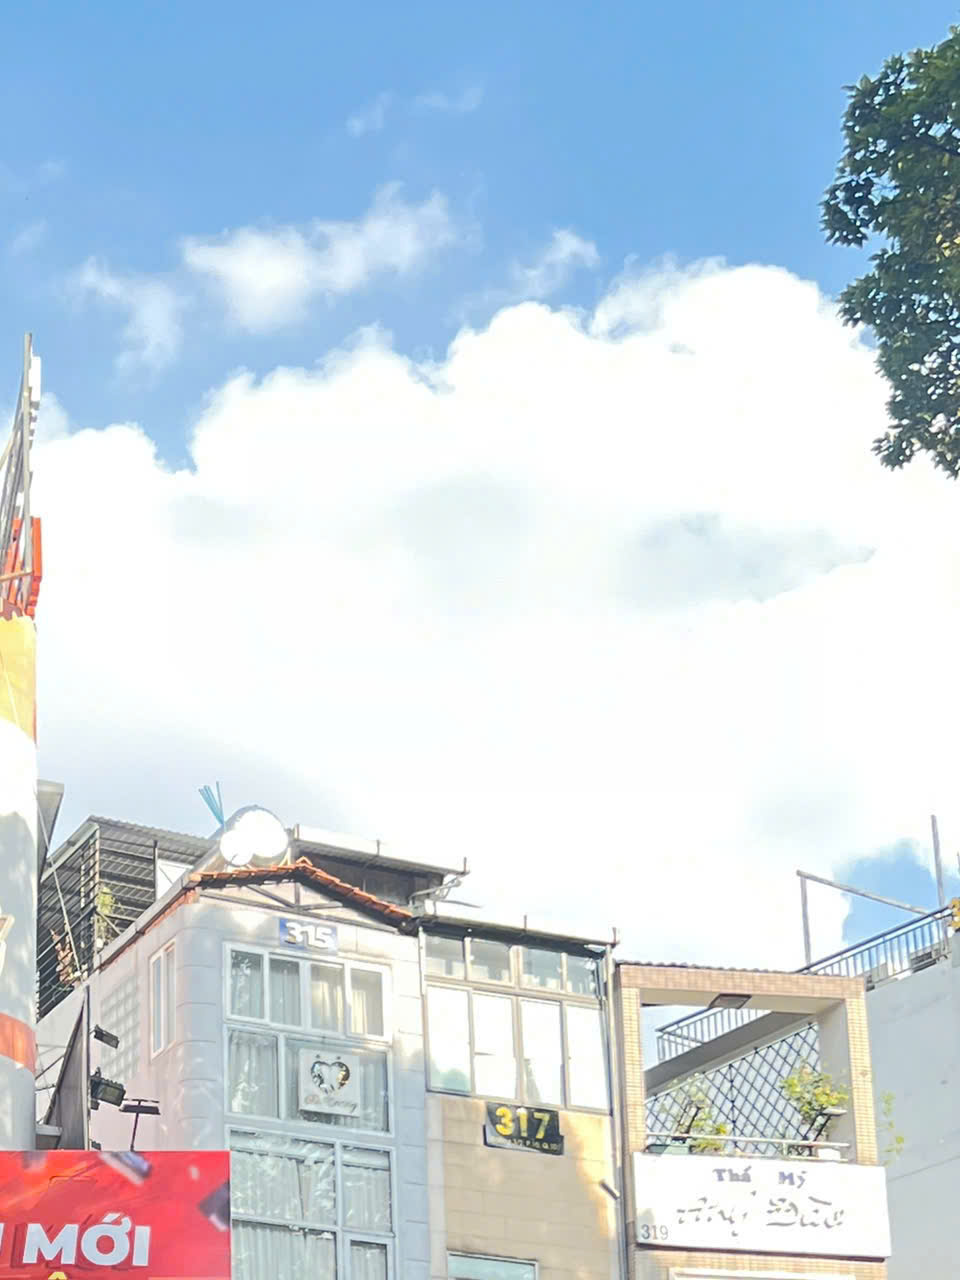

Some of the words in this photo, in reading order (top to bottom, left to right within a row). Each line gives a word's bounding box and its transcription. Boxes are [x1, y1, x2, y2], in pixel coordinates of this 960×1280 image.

[284, 922, 335, 949] 315
[495, 1106, 551, 1139] 317
[23, 1213, 151, 1267] MỚI
[641, 1225, 669, 1240] 319
